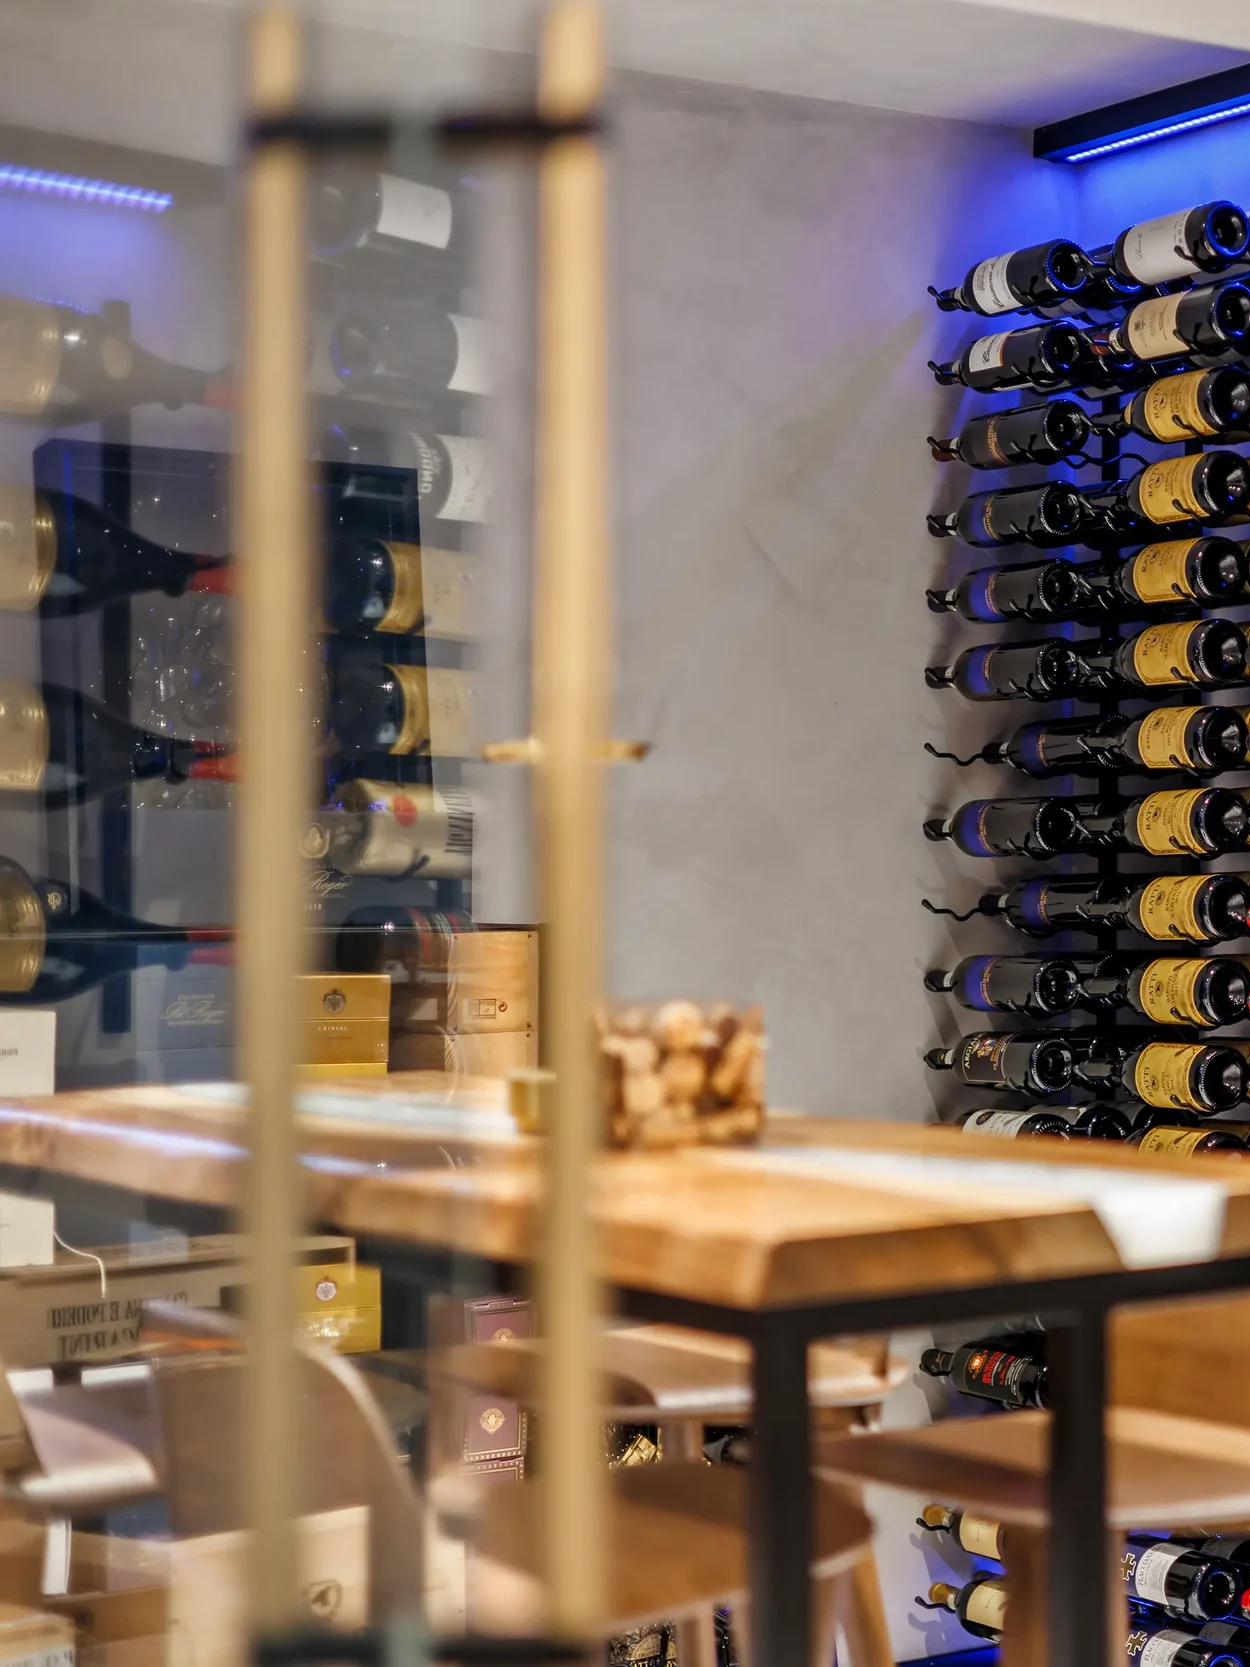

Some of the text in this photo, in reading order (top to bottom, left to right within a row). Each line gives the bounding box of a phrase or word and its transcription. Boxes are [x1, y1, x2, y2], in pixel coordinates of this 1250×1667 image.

[1146, 801, 1157, 831] RATTI
[1148, 884, 1161, 914] RATTI
[1150, 973, 1158, 1005] RATTI
[1144, 1067, 1154, 1098] RATTI
